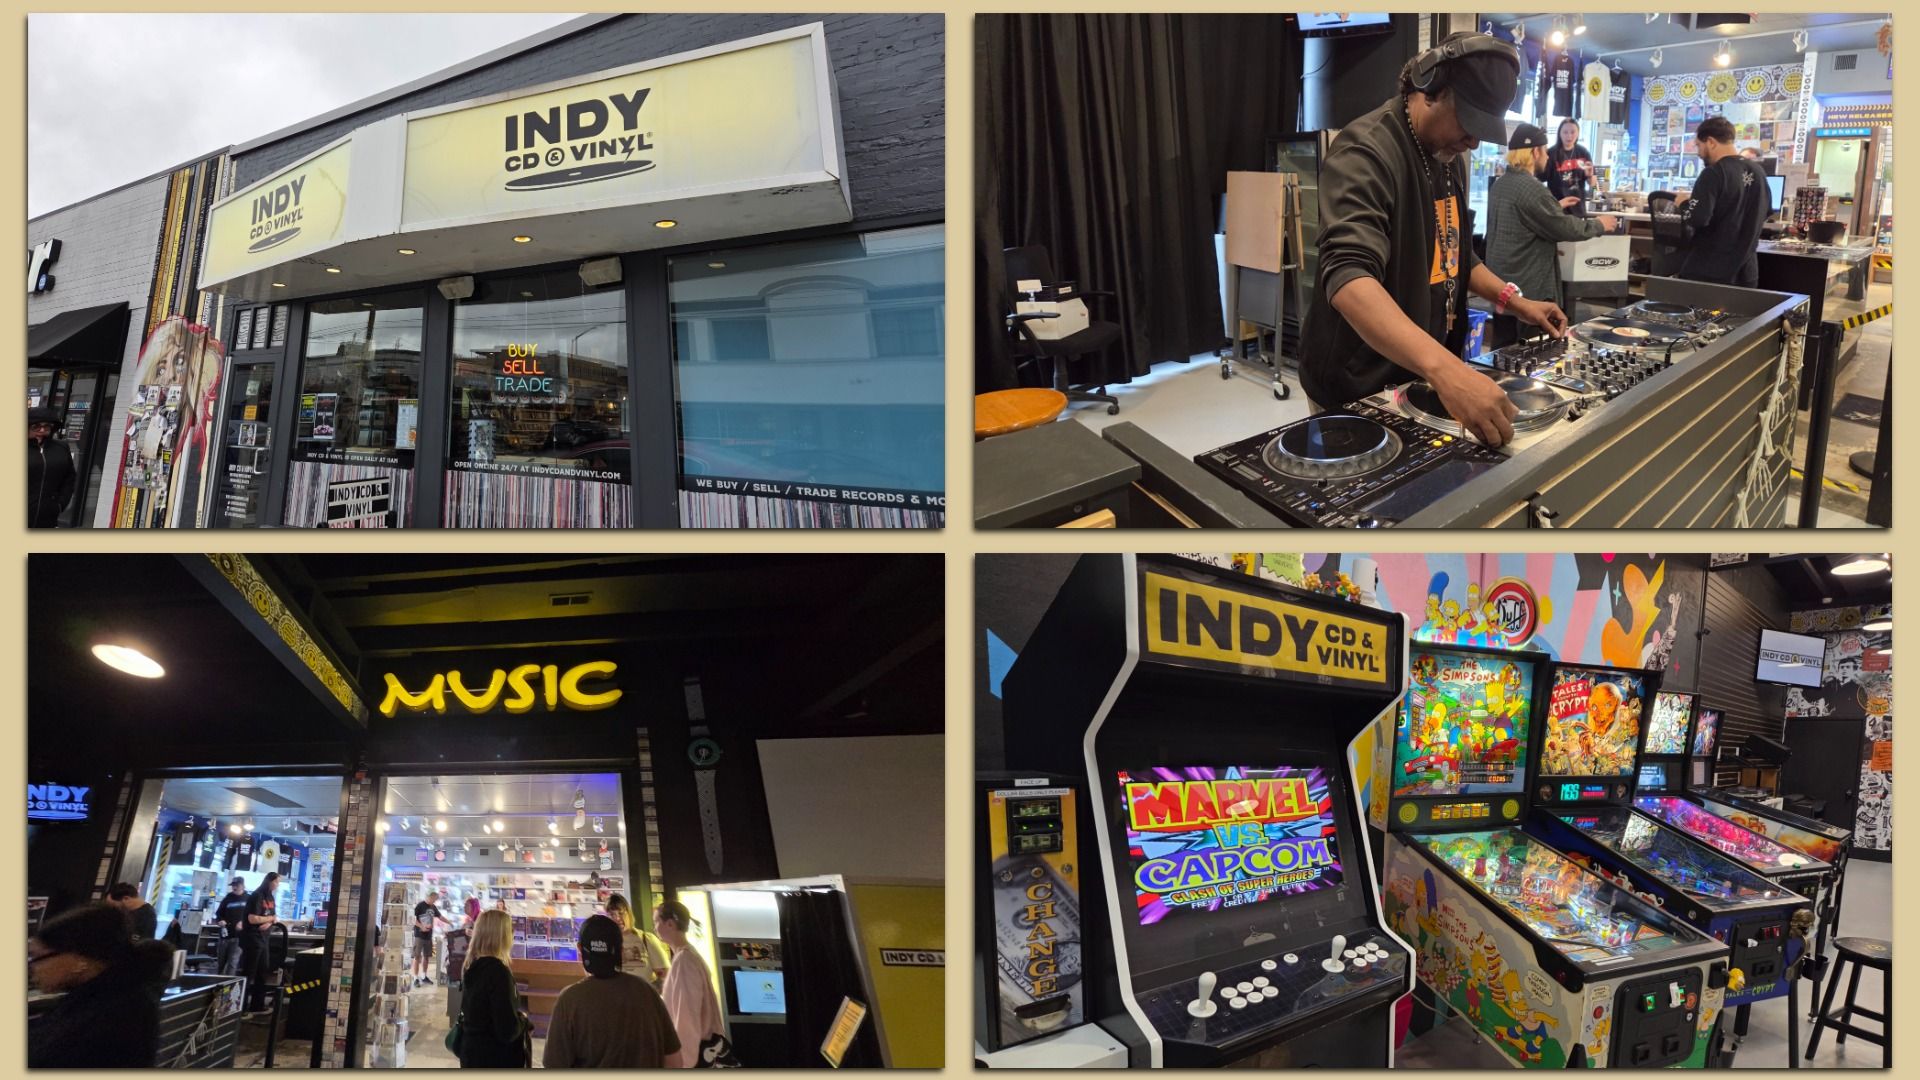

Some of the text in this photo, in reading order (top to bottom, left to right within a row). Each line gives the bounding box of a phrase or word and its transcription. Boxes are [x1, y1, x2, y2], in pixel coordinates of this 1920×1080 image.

[505, 87, 651, 152] INDY
[505, 152, 540, 172] CD
[251, 174, 306, 226] INDY
[250, 225, 263, 239] CD
[508, 343, 538, 357] BUY
[503, 359, 545, 374] SELL
[495, 377, 553, 393] TRADE
[454, 461, 621, 480] OPEN ONLINE 24/7 AT INDYCDANDVINYL.COM
[334, 486, 357, 502] INDY
[360, 484, 372, 498] CD
[696, 478, 713, 488] WE
[717, 480, 738, 490] BUY
[743, 481, 749, 491] /
[752, 482, 780, 494] SELL
[785, 485, 791, 495] /
[796, 486, 837, 499] TRADE
[842, 489, 905, 504] RECORDS
[910, 495, 921, 504] &
[346, 501, 372, 517] VINYL
[1159, 588, 1374, 662] INDY CD &
[1316, 645, 1380, 673] VINYL
[1461, 660, 1477, 670] THE
[1762, 651, 1779, 660] INDY
[1780, 653, 1791, 661] CD
[1800, 656, 1821, 666] VINYL
[1442, 668, 1496, 682] SIMPSONS
[379, 660, 623, 718] MUSIC
[1553, 683, 1583, 698] TALES
[1552, 696, 1589, 716] CRYPT
[49, 802, 88, 812] VINYL
[1125, 778, 1319, 830] MARVEL
[1213, 821, 1269, 849] VS.
[1135, 838, 1333, 892] CAPCOM
[1172, 869, 1314, 903] CLASH OF SUPER HEROES
[1023, 882, 1058, 998] CHANGE
[1437, 915, 1474, 950] SIMPSONS
[885, 952, 914, 962] INDY
[917, 953, 936, 963] CD
